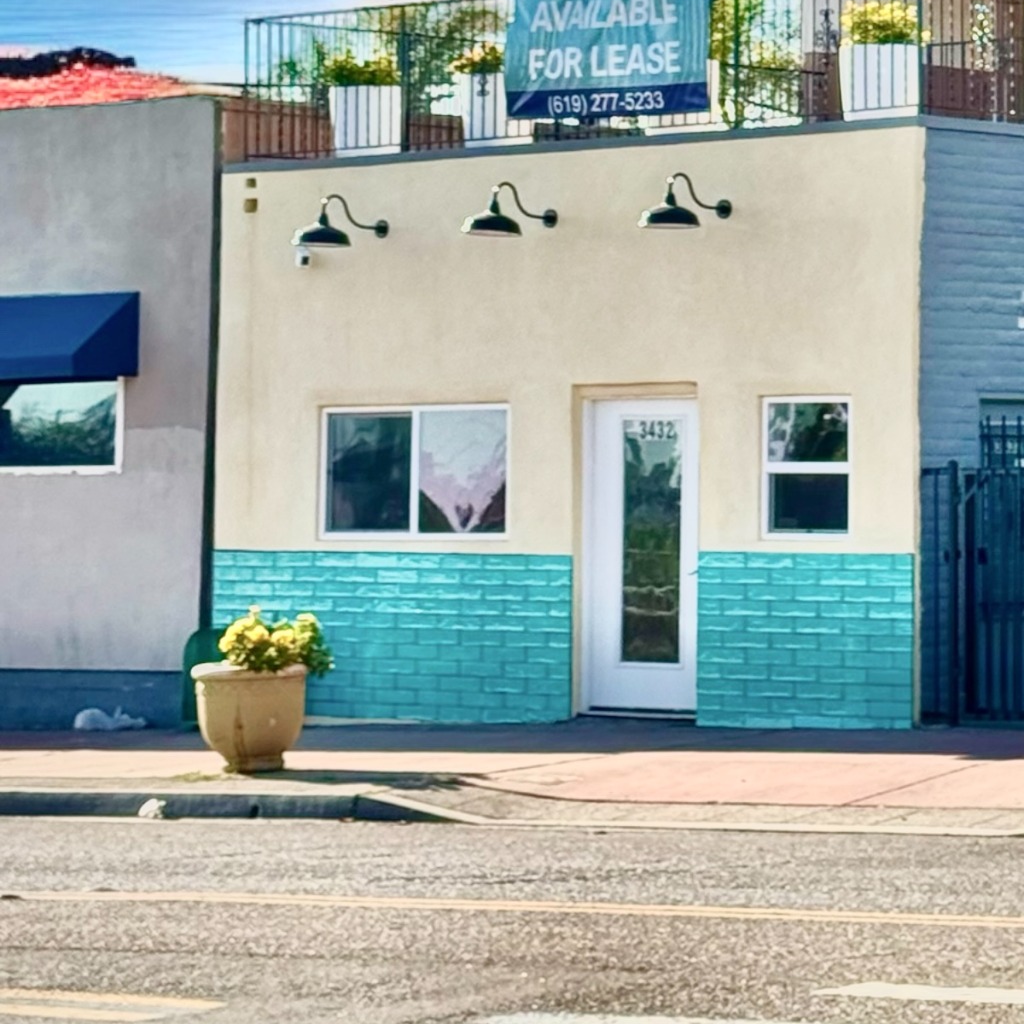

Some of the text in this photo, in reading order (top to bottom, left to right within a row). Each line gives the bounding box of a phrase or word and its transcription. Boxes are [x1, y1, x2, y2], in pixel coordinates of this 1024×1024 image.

[528, 41, 681, 80] FOR LEASE
[548, 91, 665, 116] (619) 277-5233
[639, 420, 675, 440] 3432
